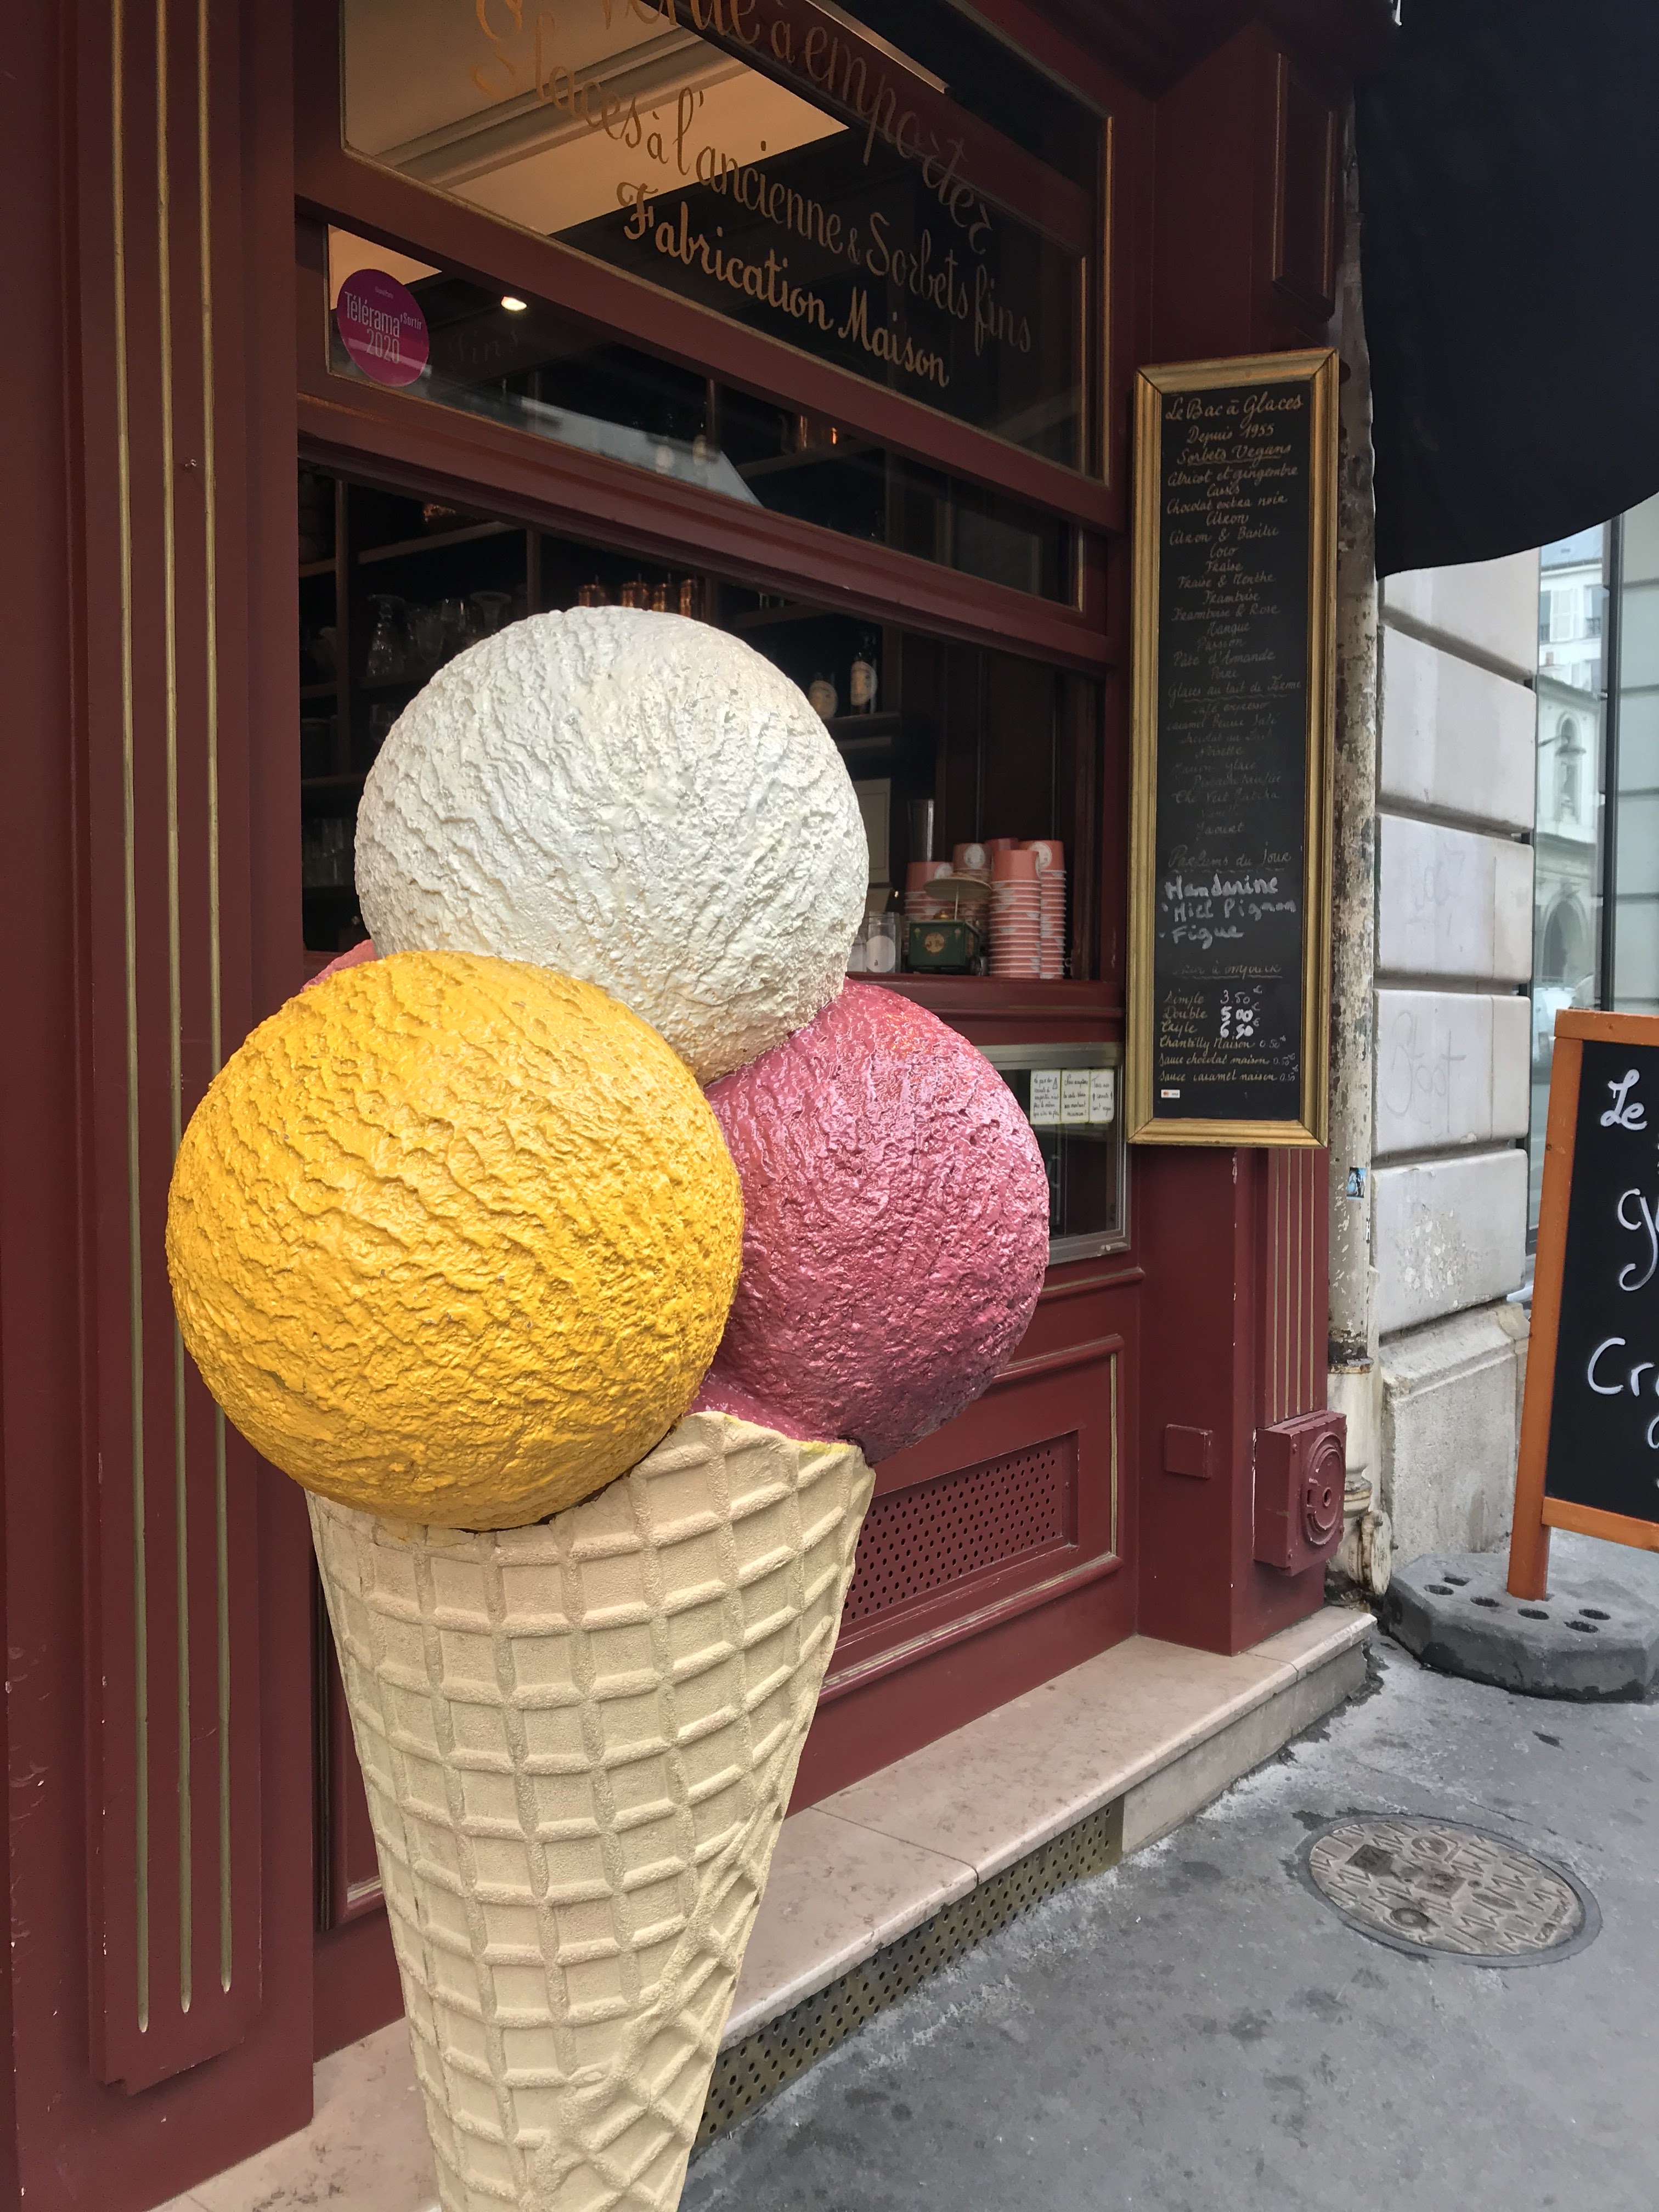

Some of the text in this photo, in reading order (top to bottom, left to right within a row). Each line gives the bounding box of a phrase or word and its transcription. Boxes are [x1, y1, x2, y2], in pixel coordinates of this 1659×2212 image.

[646, 111, 670, 165] à
[673, 87, 844, 255] l'ancienne
[847, 228, 861, 266] &
[866, 212, 969, 320] Sorbets
[974, 264, 1031, 357] fins
[616, 182, 950, 387] Fabrication Maison
[345, 291, 400, 338] Télérama
[366, 328, 400, 364] 2020
[1166, 397, 1183, 421] Le
[1187, 398, 1223, 420] Bac
[1240, 391, 1303, 429] Glaces
[1187, 424, 1274, 448] Depuis 1955
[1177, 448, 1227, 465] Sorbets
[1206, 512, 1249, 527] Citron
[1170, 530, 1212, 546] Citron
[1218, 528, 1230, 543] &
[1218, 574, 1228, 589] &
[1236, 854, 1252, 868] du
[1171, 925, 1245, 950] Figue
[1163, 1006, 1207, 1020] Double
[1160, 1037, 1210, 1057] Chantilly
[1600, 1069, 1648, 1131] Le
[1617, 1188, 1659, 1291] g
[1587, 1337, 1659, 1397] Cr
